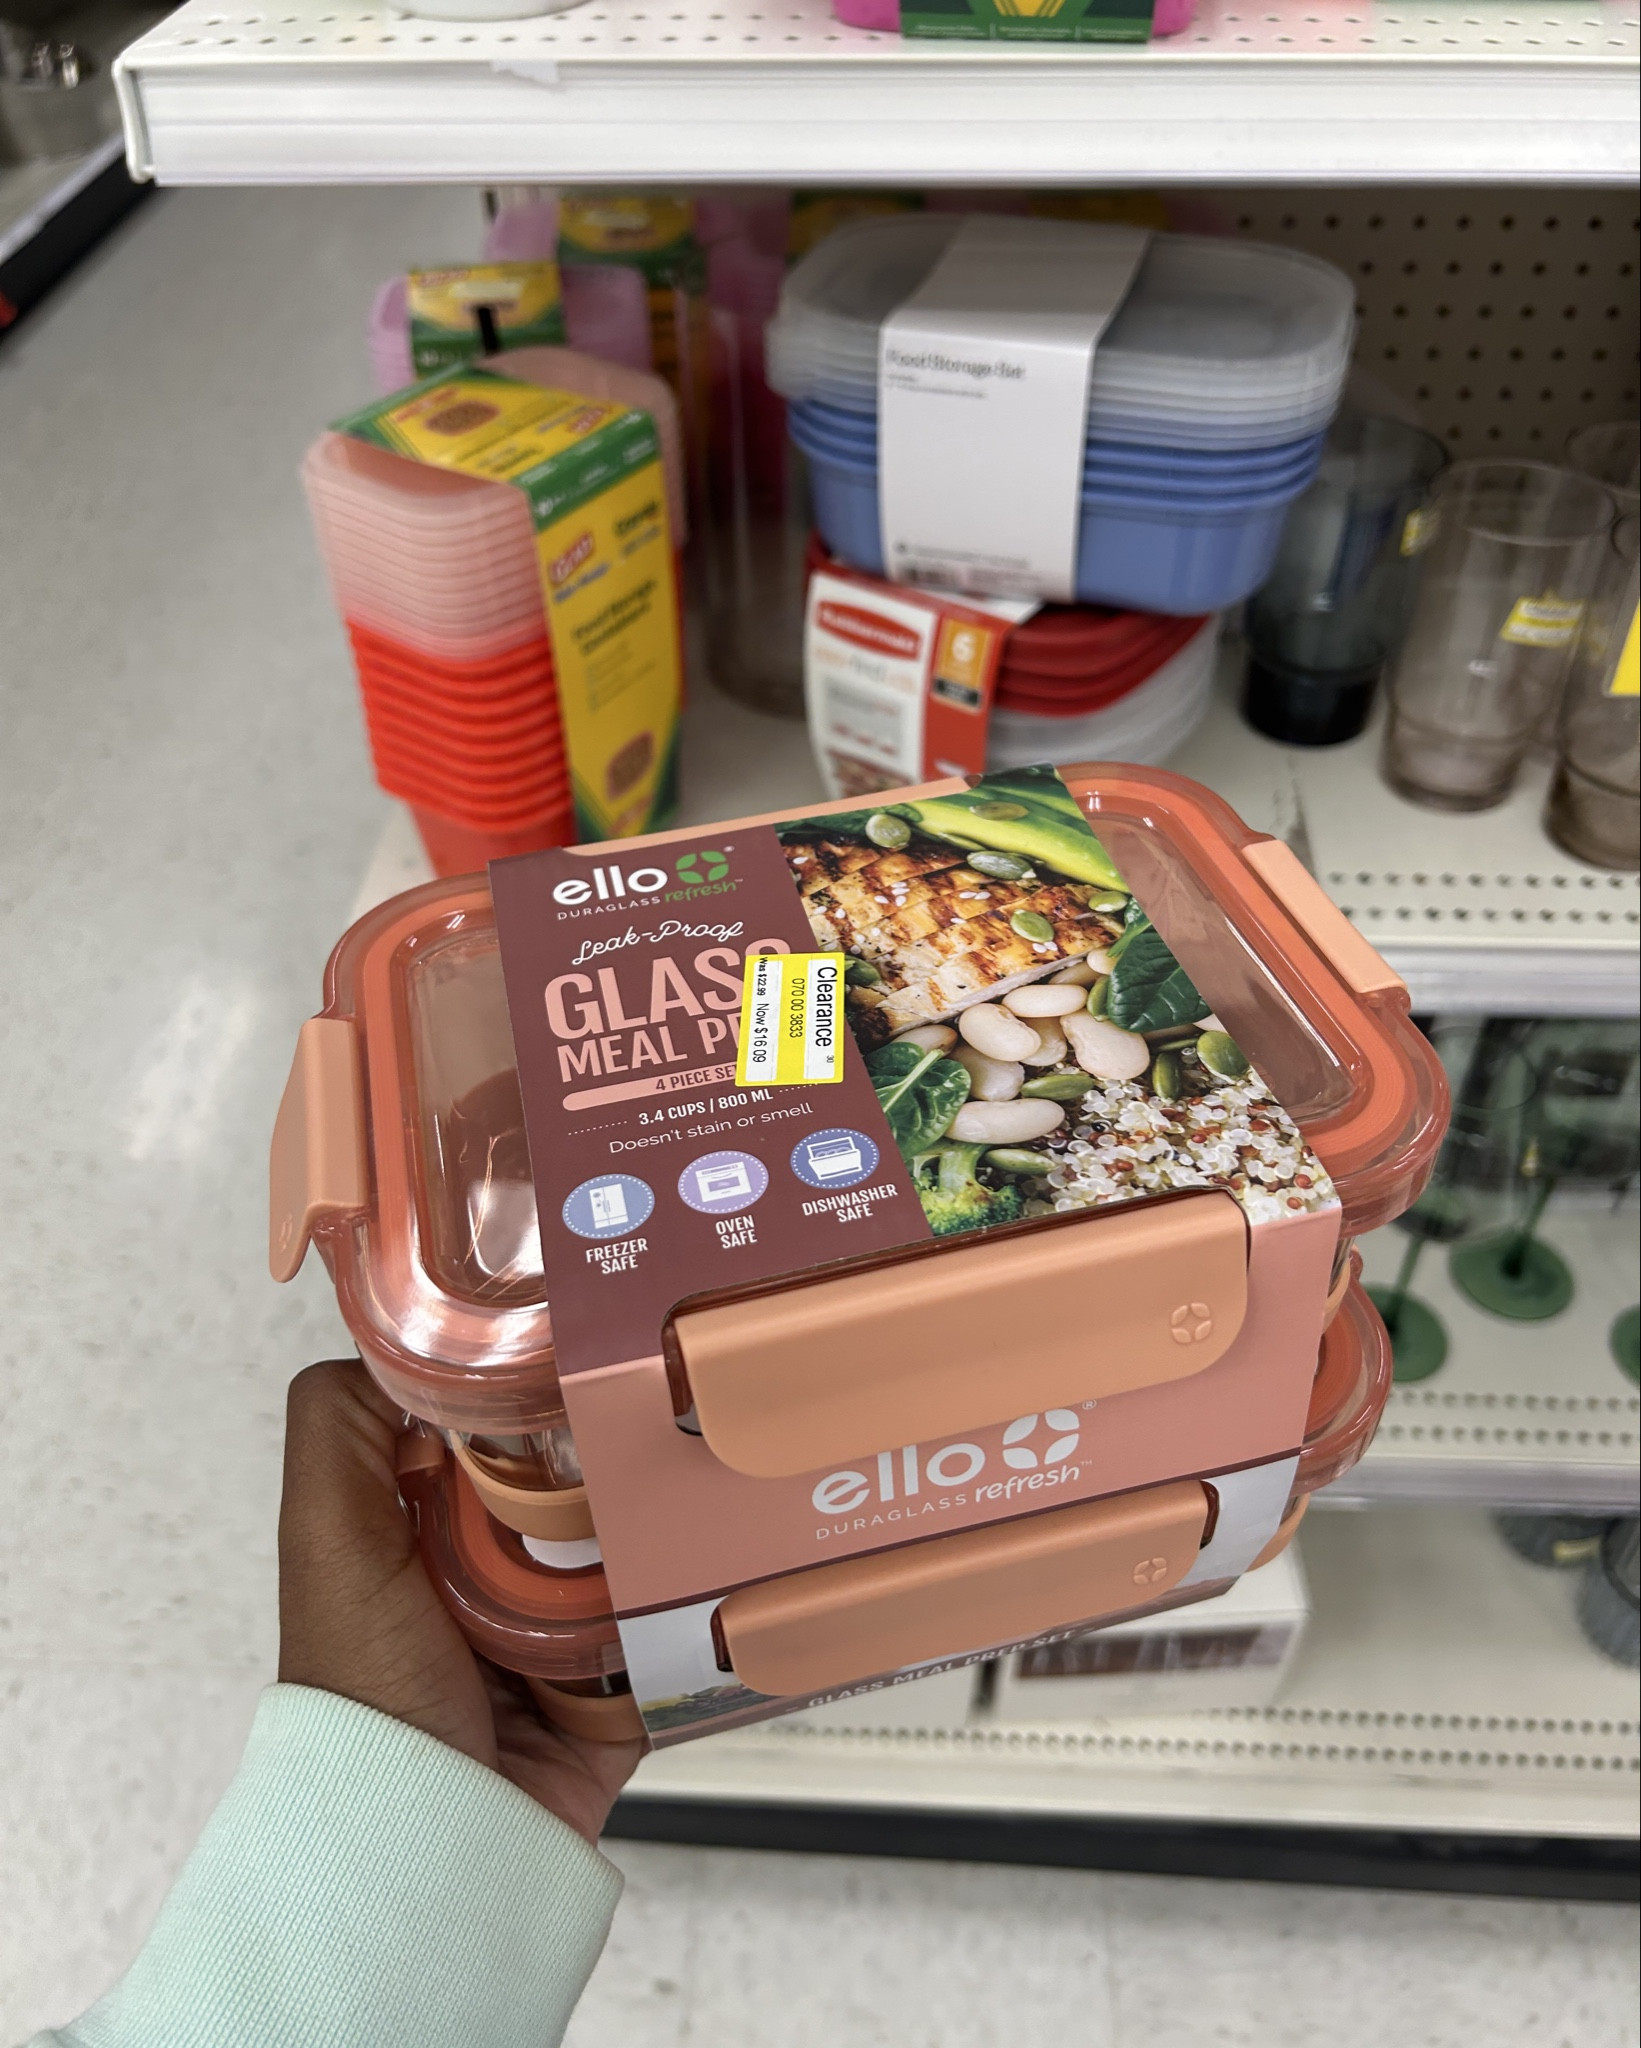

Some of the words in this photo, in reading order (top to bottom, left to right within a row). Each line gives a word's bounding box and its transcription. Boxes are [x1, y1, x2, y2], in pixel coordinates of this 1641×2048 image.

[951, 631, 977, 663] 6
[553, 865, 668, 905] ello
[557, 895, 661, 921] DURAGLASS
[664, 881, 738, 903] refresh
[571, 919, 744, 966] Leak-Proof
[758, 956, 769, 972] Was
[756, 973, 768, 996] $22.99
[791, 978, 805, 997] 070
[755, 1002, 769, 1026] Now
[790, 999, 804, 1012] 00
[815, 966, 838, 1047] Clearance
[789, 1013, 804, 1039] 3833
[557, 1025, 688, 1083] MEAL
[655, 1078, 666, 1091] 4
[670, 1069, 712, 1088] PIECE
[638, 1109, 665, 1126] 3.4
[668, 1101, 706, 1120] CUPS
[718, 1091, 748, 1110] 800
[751, 1087, 774, 1103] ML
[609, 1129, 684, 1154] Doesn't
[687, 1118, 733, 1139] stain
[736, 1114, 756, 1128] or
[760, 1101, 814, 1124] smell
[801, 1183, 898, 1217] DISHWASHER
[837, 1203, 873, 1224] SAFE
[715, 1214, 755, 1236] OVEN
[721, 1229, 758, 1250] SAFE
[585, 1238, 648, 1263] FREEZER
[600, 1254, 639, 1275] SAFE
[811, 1442, 986, 1515] ello
[815, 1493, 967, 1541] DURAGLASS
[975, 1464, 1080, 1503] refresh
[808, 1680, 885, 1708] GLASS
[893, 1662, 954, 1686] MEAL
[1031, 1630, 1076, 1649] SET
